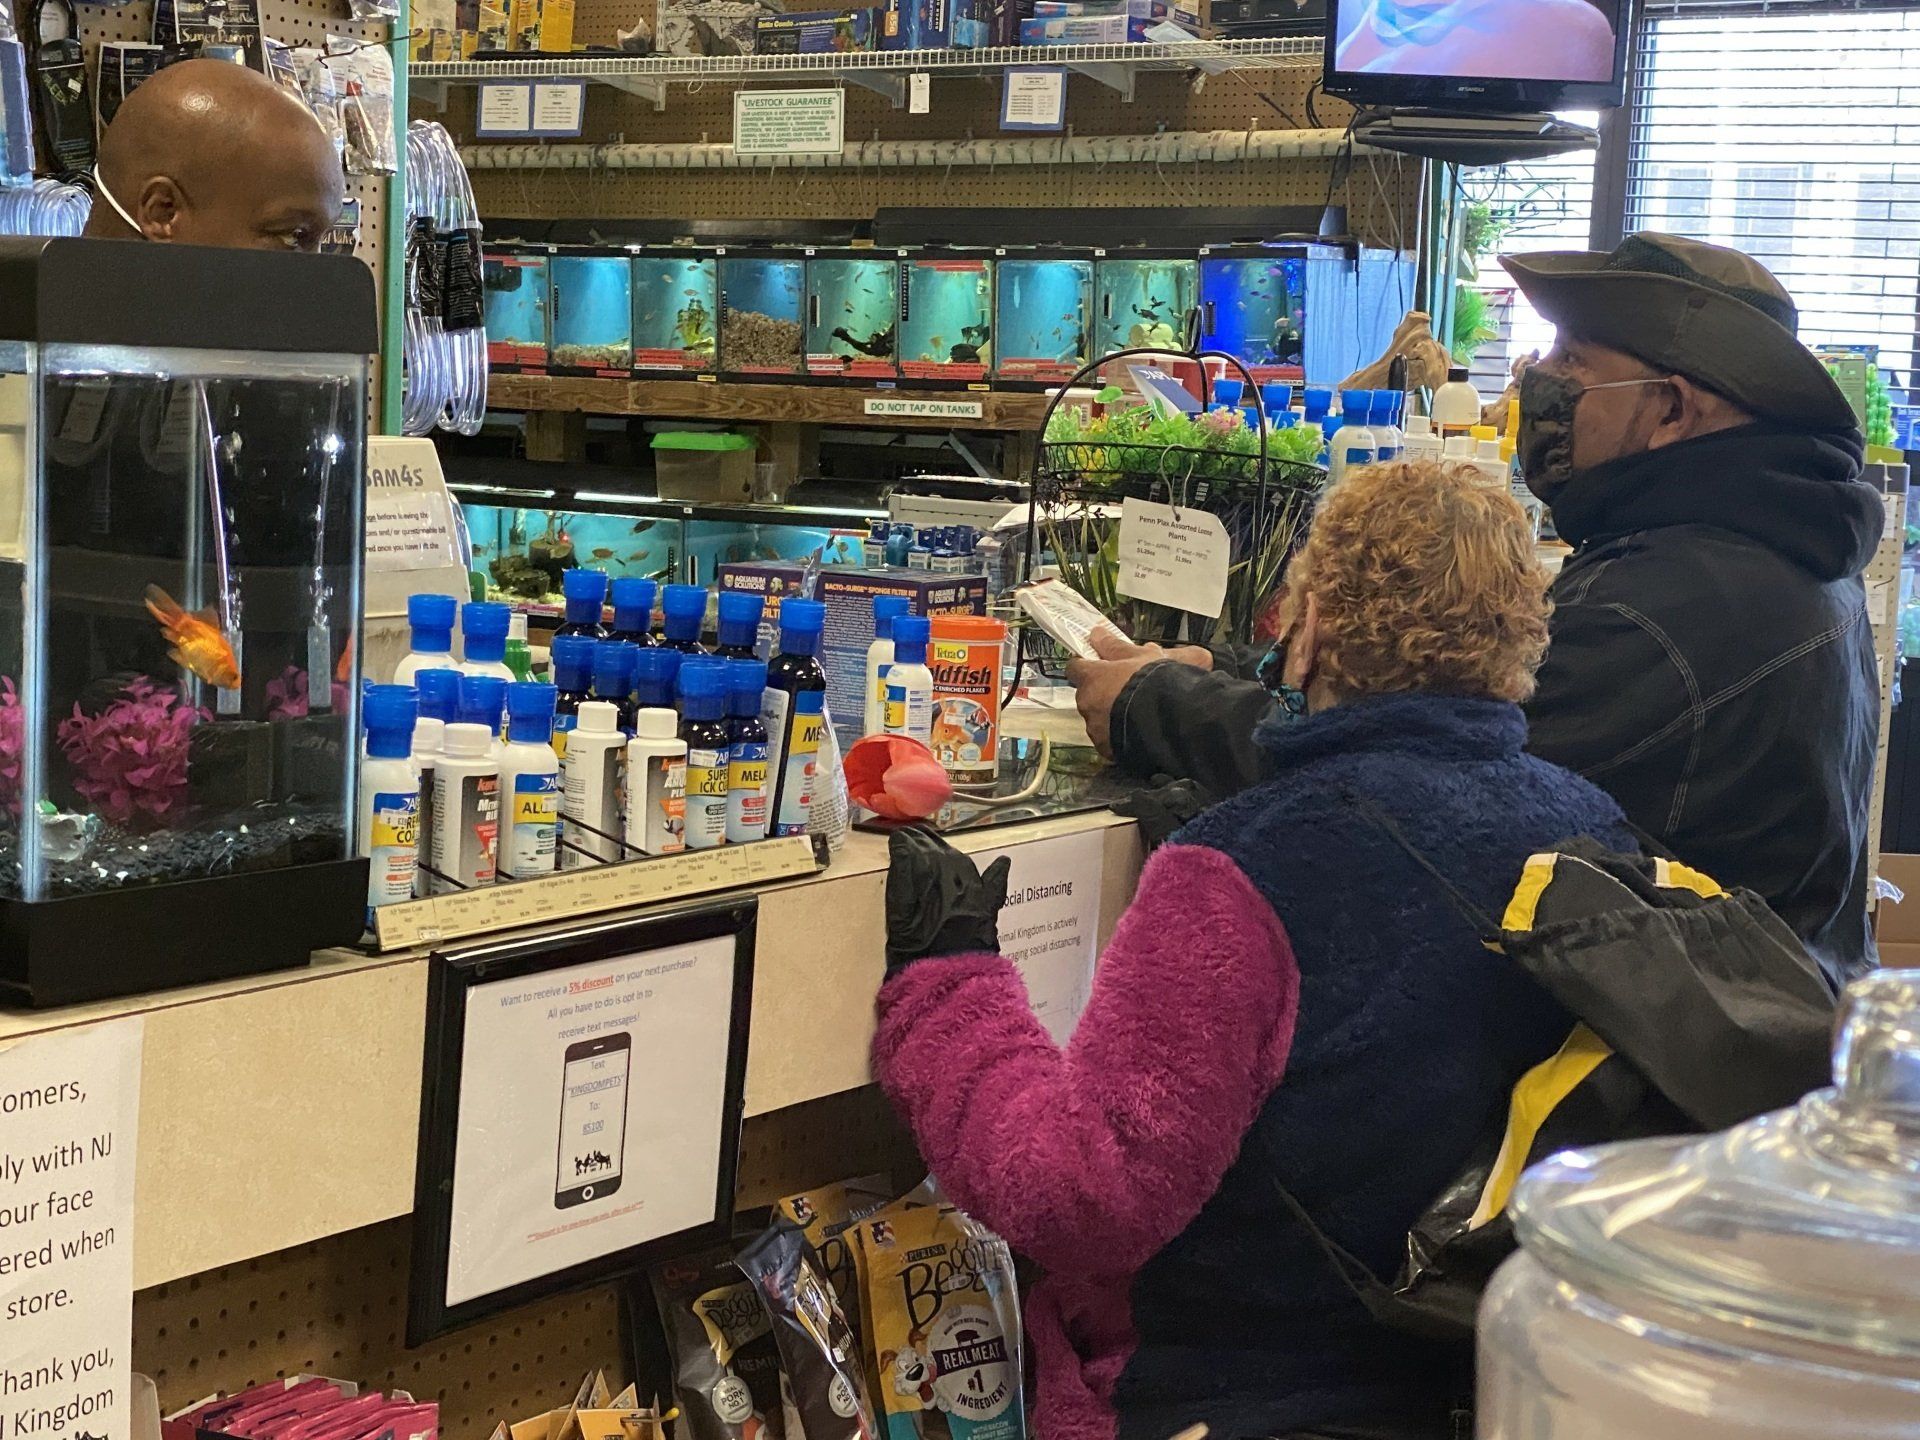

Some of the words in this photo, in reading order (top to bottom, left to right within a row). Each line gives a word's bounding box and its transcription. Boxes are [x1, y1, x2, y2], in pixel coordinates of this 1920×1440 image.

[871, 402, 884, 411] DO
[887, 403, 906, 412] NOT
[909, 404, 926, 412] TAP
[929, 404, 943, 413] ON
[947, 405, 976, 414] TANKS
[1168, 532, 1187, 541] Plants
[1171, 522, 1197, 533] Assorted
[734, 582, 765, 590] SOLUTIONS
[735, 575, 766, 583] AQUARIUM
[868, 586, 891, 595] SPONGE
[891, 588, 907, 596] FILTER
[936, 648, 956, 659] Tetra
[700, 781, 716, 793] ICK
[1004, 888, 1024, 907] ocial
[1026, 880, 1073, 902] Distancing
[998, 929, 1016, 943] nimal
[1017, 924, 1046, 940] Kingdom
[1047, 922, 1053, 932] is
[1053, 915, 1079, 931] actively
[1029, 942, 1048, 957] social
[1049, 935, 1081, 950] distancing
[500, 995, 522, 1008] Want
[523, 993, 532, 1003] to
[533, 986, 562, 1001] receive
[569, 980, 581, 993] 5%
[581, 974, 615, 991] discount
[615, 974, 626, 983] on
[626, 970, 644, 983] your
[644, 966, 661, 977] next
[661, 956, 698, 976] purchase?
[547, 1008, 558, 1020] All
[559, 1007, 573, 1018] you
[575, 1001, 593, 1013] have
[594, 1000, 603, 1009] to
[603, 997, 615, 1007] do
[616, 995, 622, 1005] is
[622, 993, 636, 1005] opt
[636, 991, 644, 1000] in
[644, 989, 653, 999] to
[558, 1024, 586, 1040] receive
[587, 1021, 602, 1034] text
[602, 1013, 641, 1029] messages!
[590, 1059, 606, 1070] Text
[0, 1081, 87, 1114] omers,
[589, 1100, 601, 1111] To:
[0, 1154, 25, 1184] ly
[32, 1140, 83, 1174] with
[91, 1131, 113, 1161] NJ
[0, 1202, 39, 1228] our
[47, 1189, 94, 1218] face
[0, 1239, 52, 1275] ered
[61, 1226, 115, 1261] when
[6, 1289, 74, 1320] store.
[70, 1347, 114, 1383] you,
[942, 1350, 972, 1370] REAL
[971, 1342, 1001, 1362] MEAT
[967, 1369, 984, 1393] #1
[721, 1388, 745, 1405] PORK
[957, 1381, 1007, 1410] INGREDIENT
[14, 1387, 114, 1438] Kingdom
